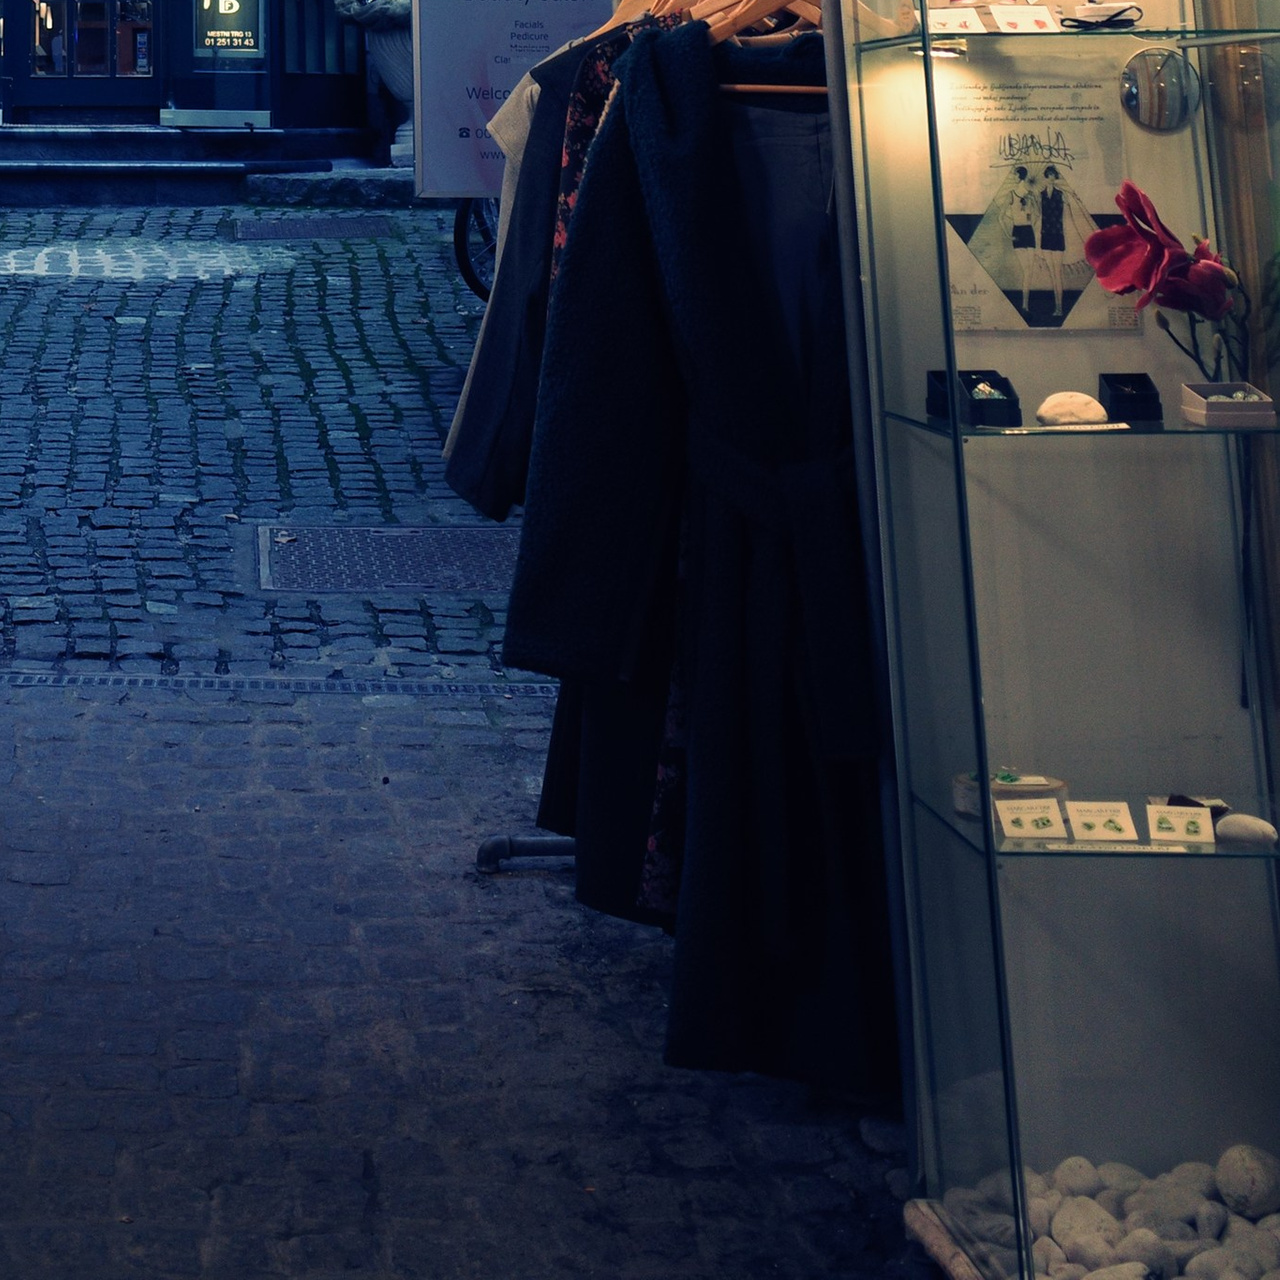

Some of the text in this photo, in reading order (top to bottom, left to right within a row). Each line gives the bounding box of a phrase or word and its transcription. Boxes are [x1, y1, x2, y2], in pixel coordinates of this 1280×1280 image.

[514, 20, 544, 29] Facials
[510, 31, 549, 41] Pedicure
[204, 37, 254, 47] 01 251 31 43
